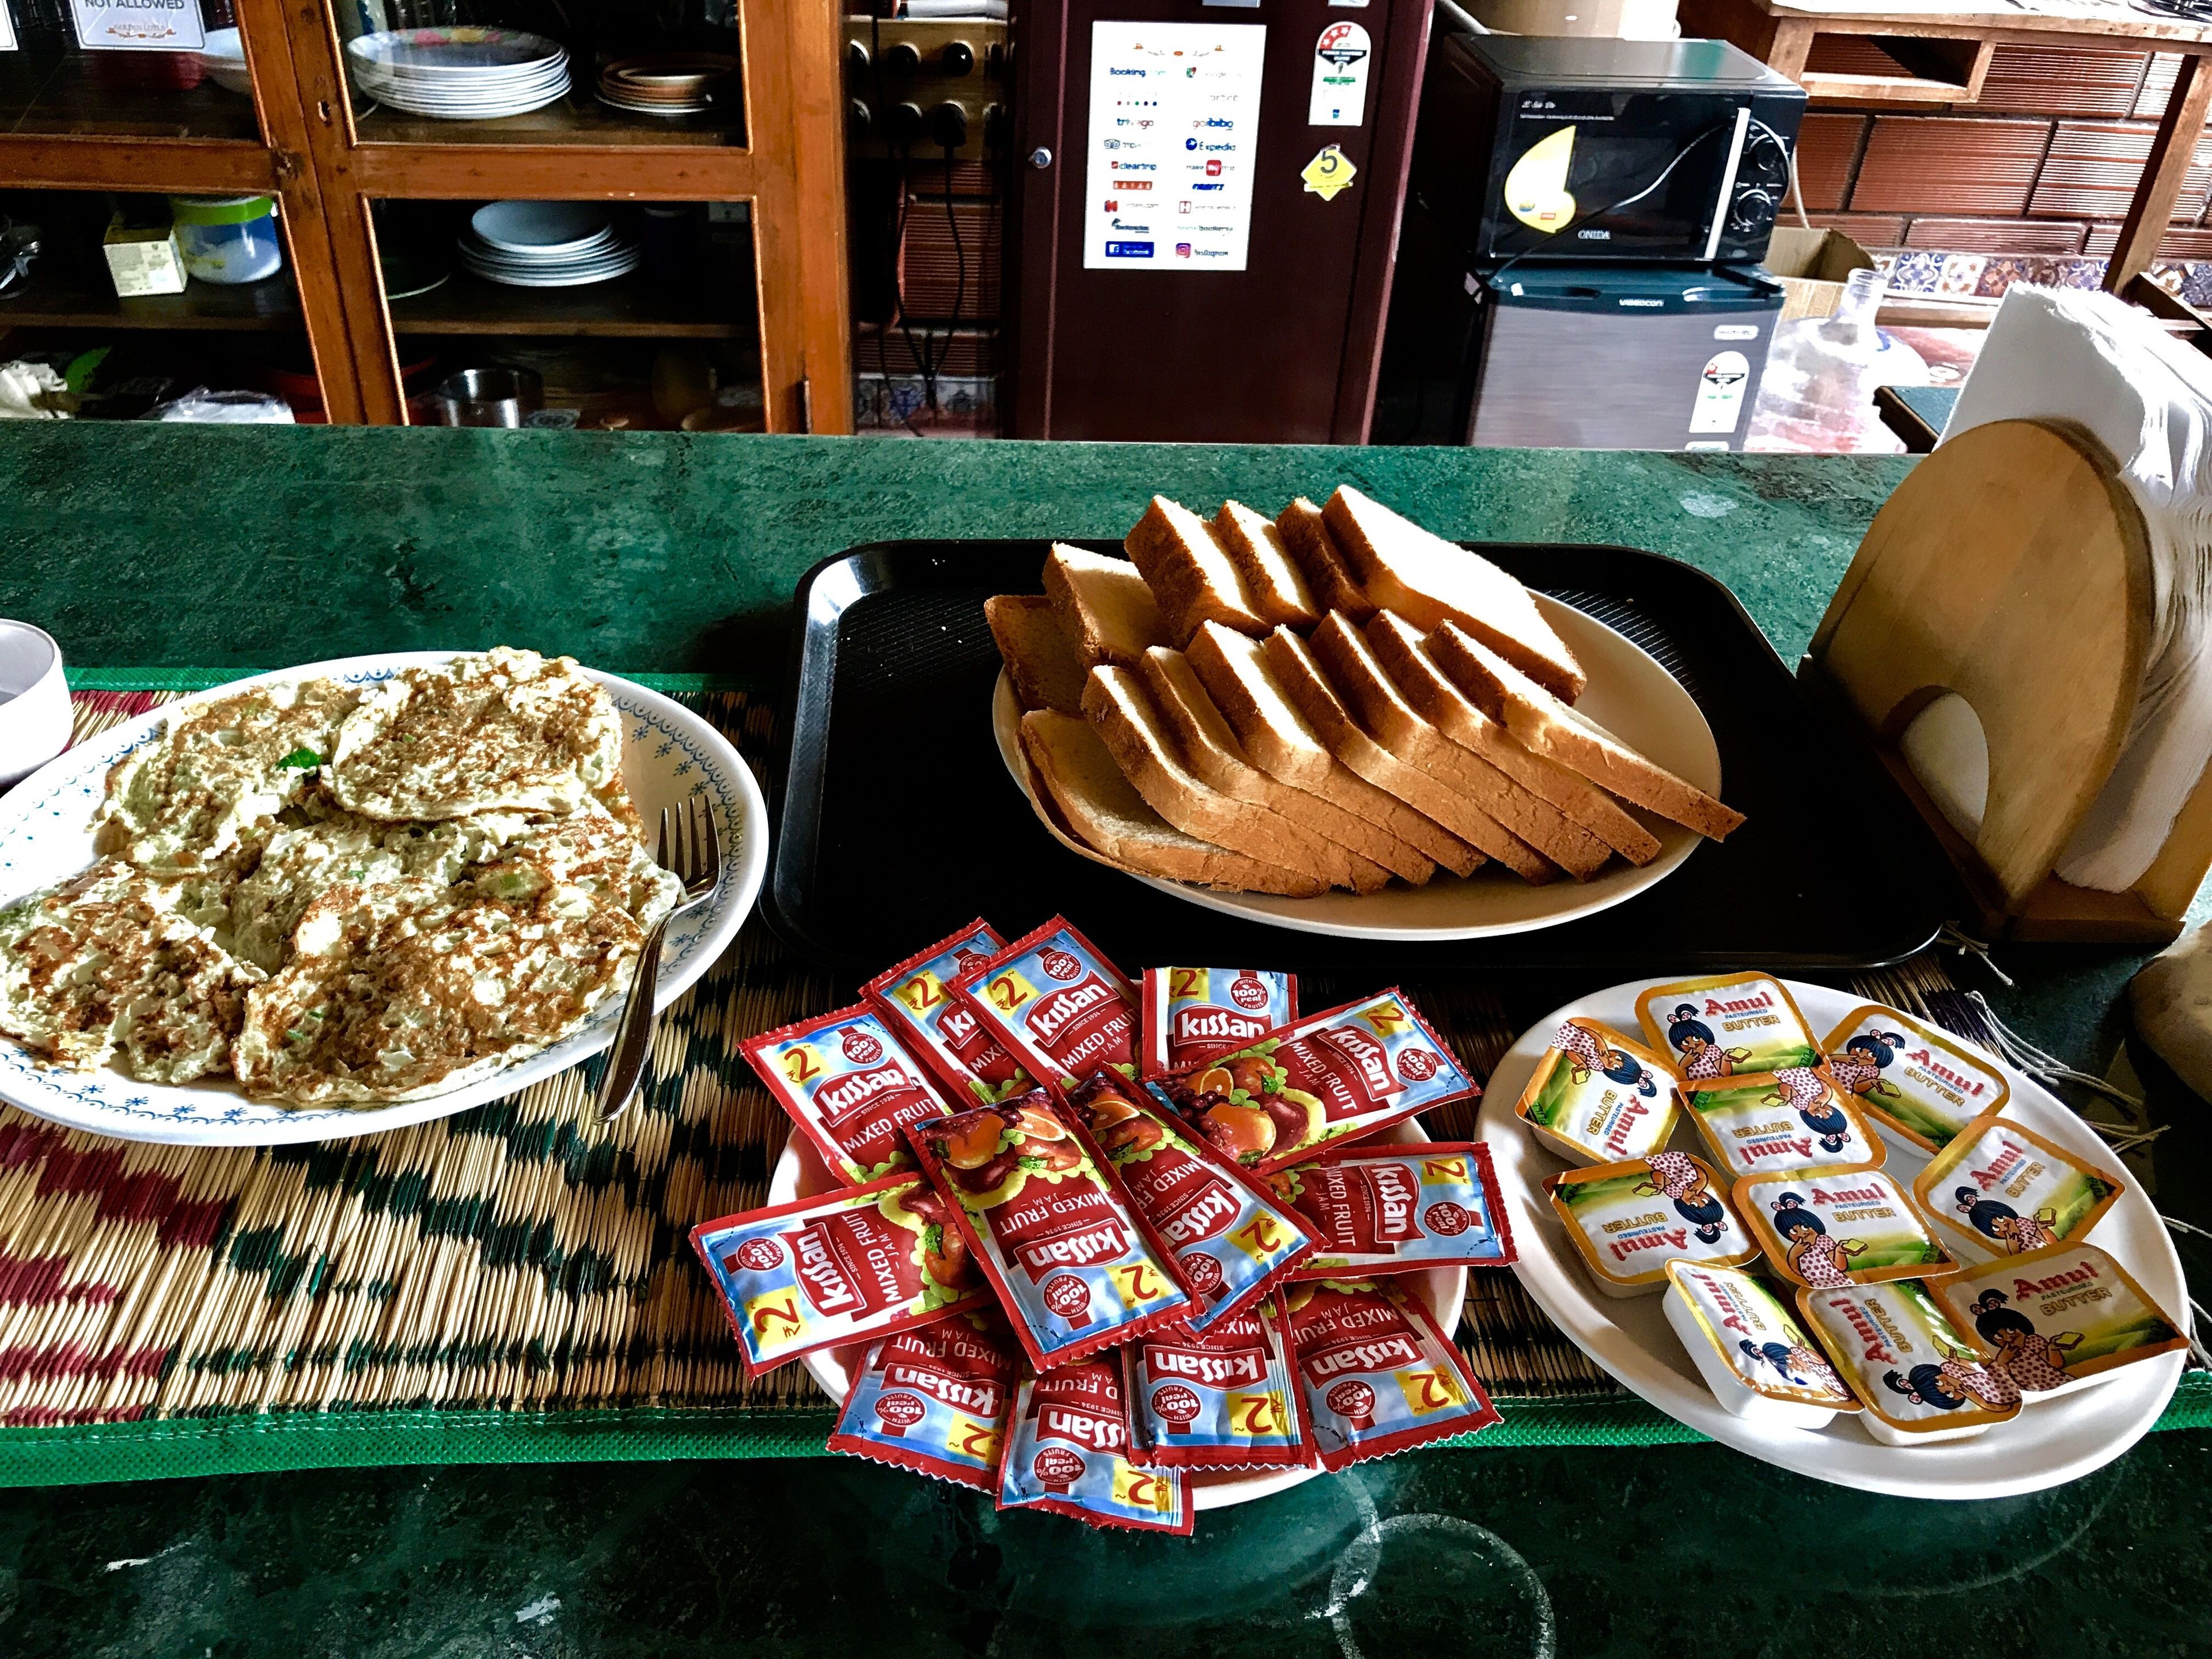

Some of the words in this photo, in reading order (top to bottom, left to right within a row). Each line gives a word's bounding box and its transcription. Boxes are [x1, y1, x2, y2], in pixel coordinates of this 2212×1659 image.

[85, 0, 110, 8] NOT
[115, 0, 185, 9] ALLOWED
[1320, 146, 1338, 173] 5
[1578, 230, 1611, 239] ONIDA
[1049, 954, 1072, 977] 100%
[1059, 961, 1075, 978] real
[1233, 988, 1266, 997] 100%
[1705, 991, 1774, 1016] Amul
[1072, 1020, 1089, 1031] SINCE
[1722, 1014, 1781, 1032] BUTTER
[847, 1036, 874, 1059] 100%
[1060, 1033, 1104, 1070] MIXED
[1103, 1008, 1139, 1037] FRUIT
[1101, 1036, 1123, 1055] JAM
[858, 1045, 876, 1060] real
[865, 1048, 882, 1063] FRUITS
[1403, 1050, 1433, 1078] 100%
[1421, 1052, 1434, 1063] WITH
[1289, 1041, 1327, 1074] MIXED
[1325, 1071, 1358, 1111] FRUIT
[1299, 1069, 1321, 1086] JAM
[1402, 1059, 1423, 1077] real
[1906, 1049, 1984, 1096] Amul
[1904, 1066, 1965, 1107] BUTTER
[1918, 1066, 1964, 1094] PASTEURISED
[861, 1101, 880, 1115] SINCE
[1586, 1089, 1618, 1135] BUTTER
[1604, 1102, 1624, 1135] PASTEURISED
[842, 1118, 893, 1153] MIXED
[893, 1099, 937, 1126] FRUIT
[1604, 1094, 1649, 1155] Amul
[1732, 1121, 1794, 1138] BUTTER
[1738, 1137, 1812, 1165] Amul
[1153, 1161, 1202, 1192] MIXED
[1969, 1140, 2022, 1191] Amul
[1133, 1169, 1157, 1192] JAM
[1326, 1168, 1348, 1200] MIXED
[2005, 1161, 2045, 1198] BUTTER
[1032, 1192, 1058, 1206] JAM
[1052, 1191, 1106, 1214] MIXED
[1169, 1192, 1189, 1209] SINCE
[1316, 1192, 1330, 1211] JAM
[1811, 1183, 1888, 1206] Amul
[999, 1206, 1050, 1236] FRUIT
[1062, 1219, 1082, 1230] SINCE
[1332, 1204, 1356, 1247] FRUIT
[1437, 1203, 1463, 1234] 100%
[1602, 1212, 1668, 1233] BUTTER
[1832, 1207, 1897, 1222] BUTTER
[842, 1213, 877, 1247] FRUIT
[1618, 1226, 1666, 1239] PASTEURISED
[744, 1242, 774, 1269] 100%
[757, 1243, 778, 1262] real
[878, 1233, 900, 1256] JAM
[1609, 1227, 1688, 1261] Amul
[843, 1255, 858, 1273] SINCE
[867, 1249, 903, 1302] MIXED
[1046, 1276, 1067, 1293] FRUITS
[1052, 1280, 1074, 1297] real
[2013, 1262, 2099, 1302] Amul
[1051, 1284, 1087, 1312] 100%
[1691, 1274, 1752, 1336] Amul
[1724, 1282, 1767, 1331] BUTTER
[2039, 1287, 2112, 1316] BUTTER
[1320, 1302, 1349, 1320] JAM
[1341, 1308, 1400, 1329] MIXED
[942, 1328, 969, 1342] JAM
[1829, 1298, 1898, 1364] Amul
[1864, 1298, 1914, 1353] BUTTER
[891, 1335, 947, 1358] FRUIT
[954, 1342, 1012, 1370] MIXED
[1040, 1379, 1097, 1393] FRUIT
[1092, 1372, 1113, 1382] AM
[1158, 1385, 1183, 1396] FRUITS
[1161, 1393, 1188, 1404] real
[1332, 1387, 1372, 1412] 100%
[877, 1406, 923, 1415] 100%
[1156, 1399, 1199, 1412] 100%
[1043, 1449, 1071, 1457] FRUITS
[1045, 1457, 1074, 1466] real
[1037, 1465, 1084, 1477] 100%
